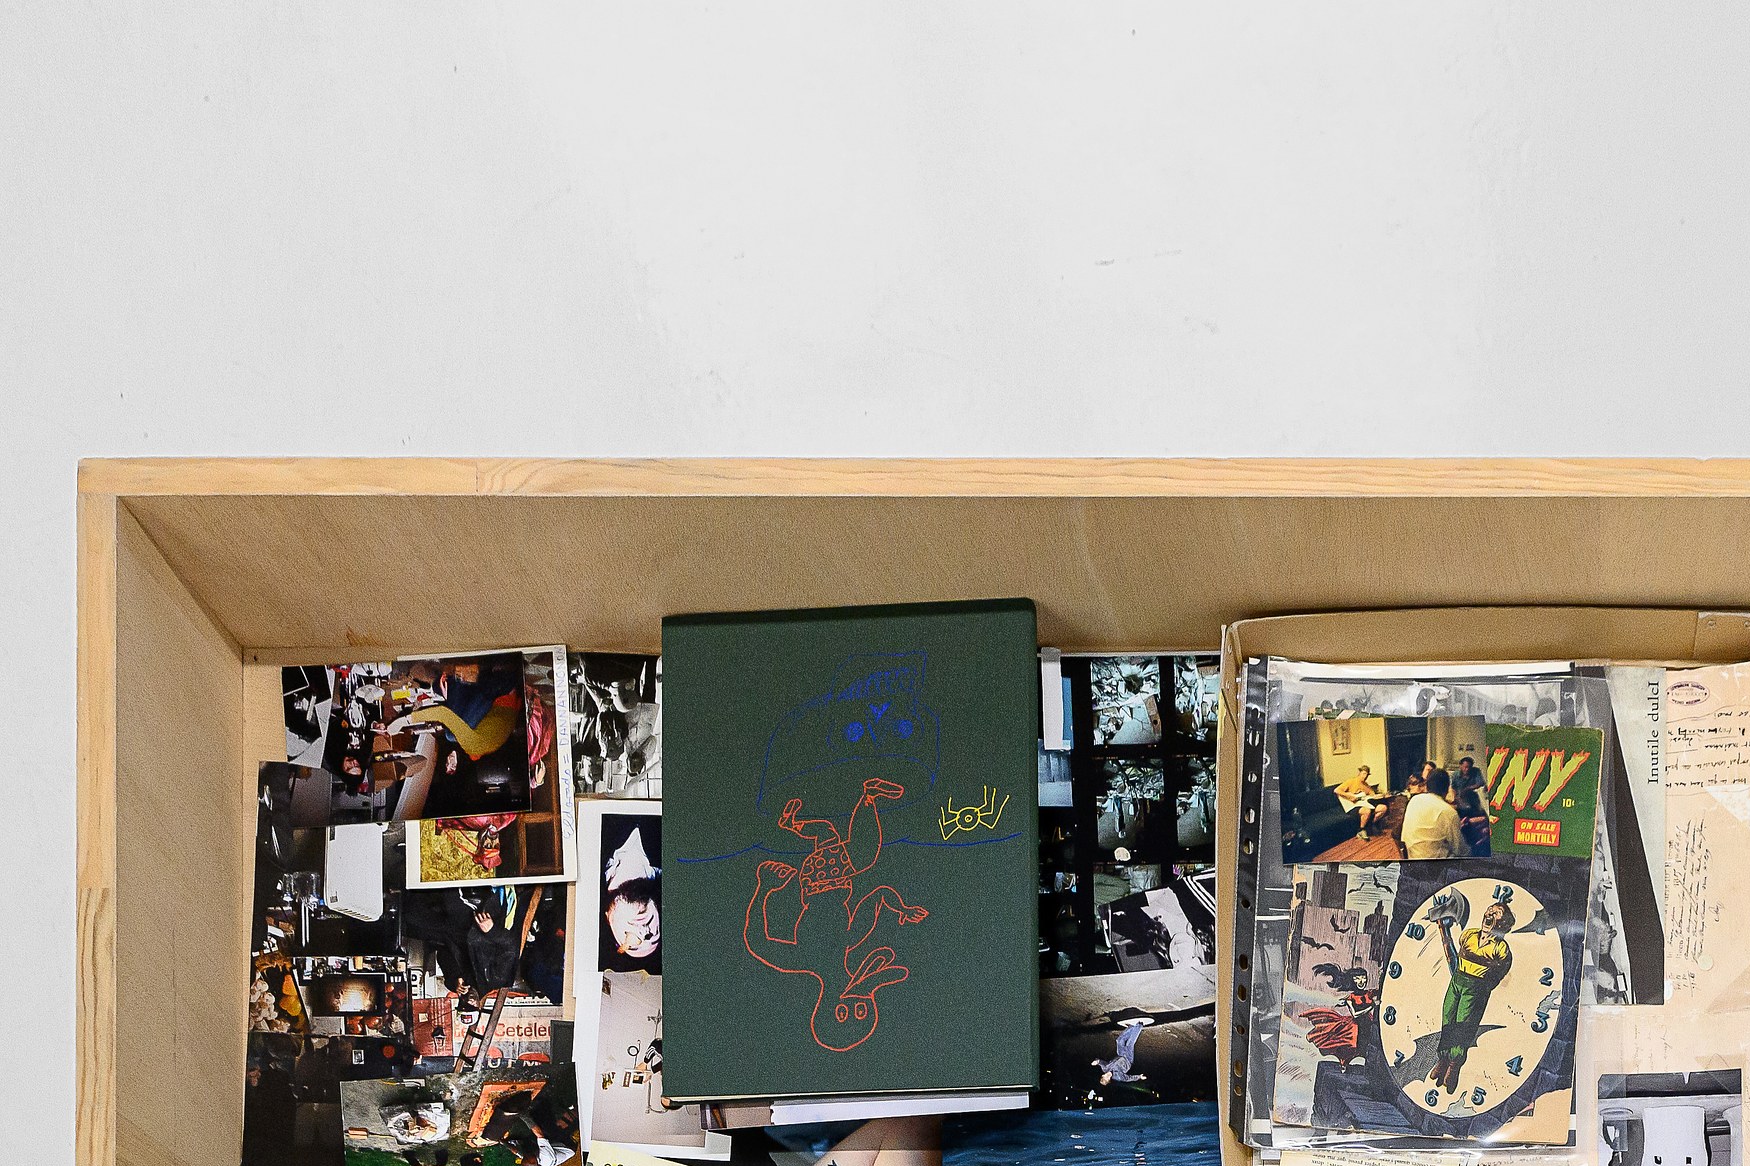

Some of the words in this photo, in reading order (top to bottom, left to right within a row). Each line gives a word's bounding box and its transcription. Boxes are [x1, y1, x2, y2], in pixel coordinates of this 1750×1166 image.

[1646, 729, 1659, 785] Inutile
[1521, 821, 1533, 830] ON
[1535, 822, 1557, 832] SALE
[1516, 831, 1557, 844] MONTHLY
[1388, 960, 1402, 979] 9
[1539, 967, 1555, 987] 2
[1383, 1005, 1397, 1026] 8
[1531, 1009, 1550, 1033] 3
[1505, 1054, 1524, 1077] 4
[1424, 1088, 1439, 1106] 6
[1471, 1086, 1487, 1105] 5
